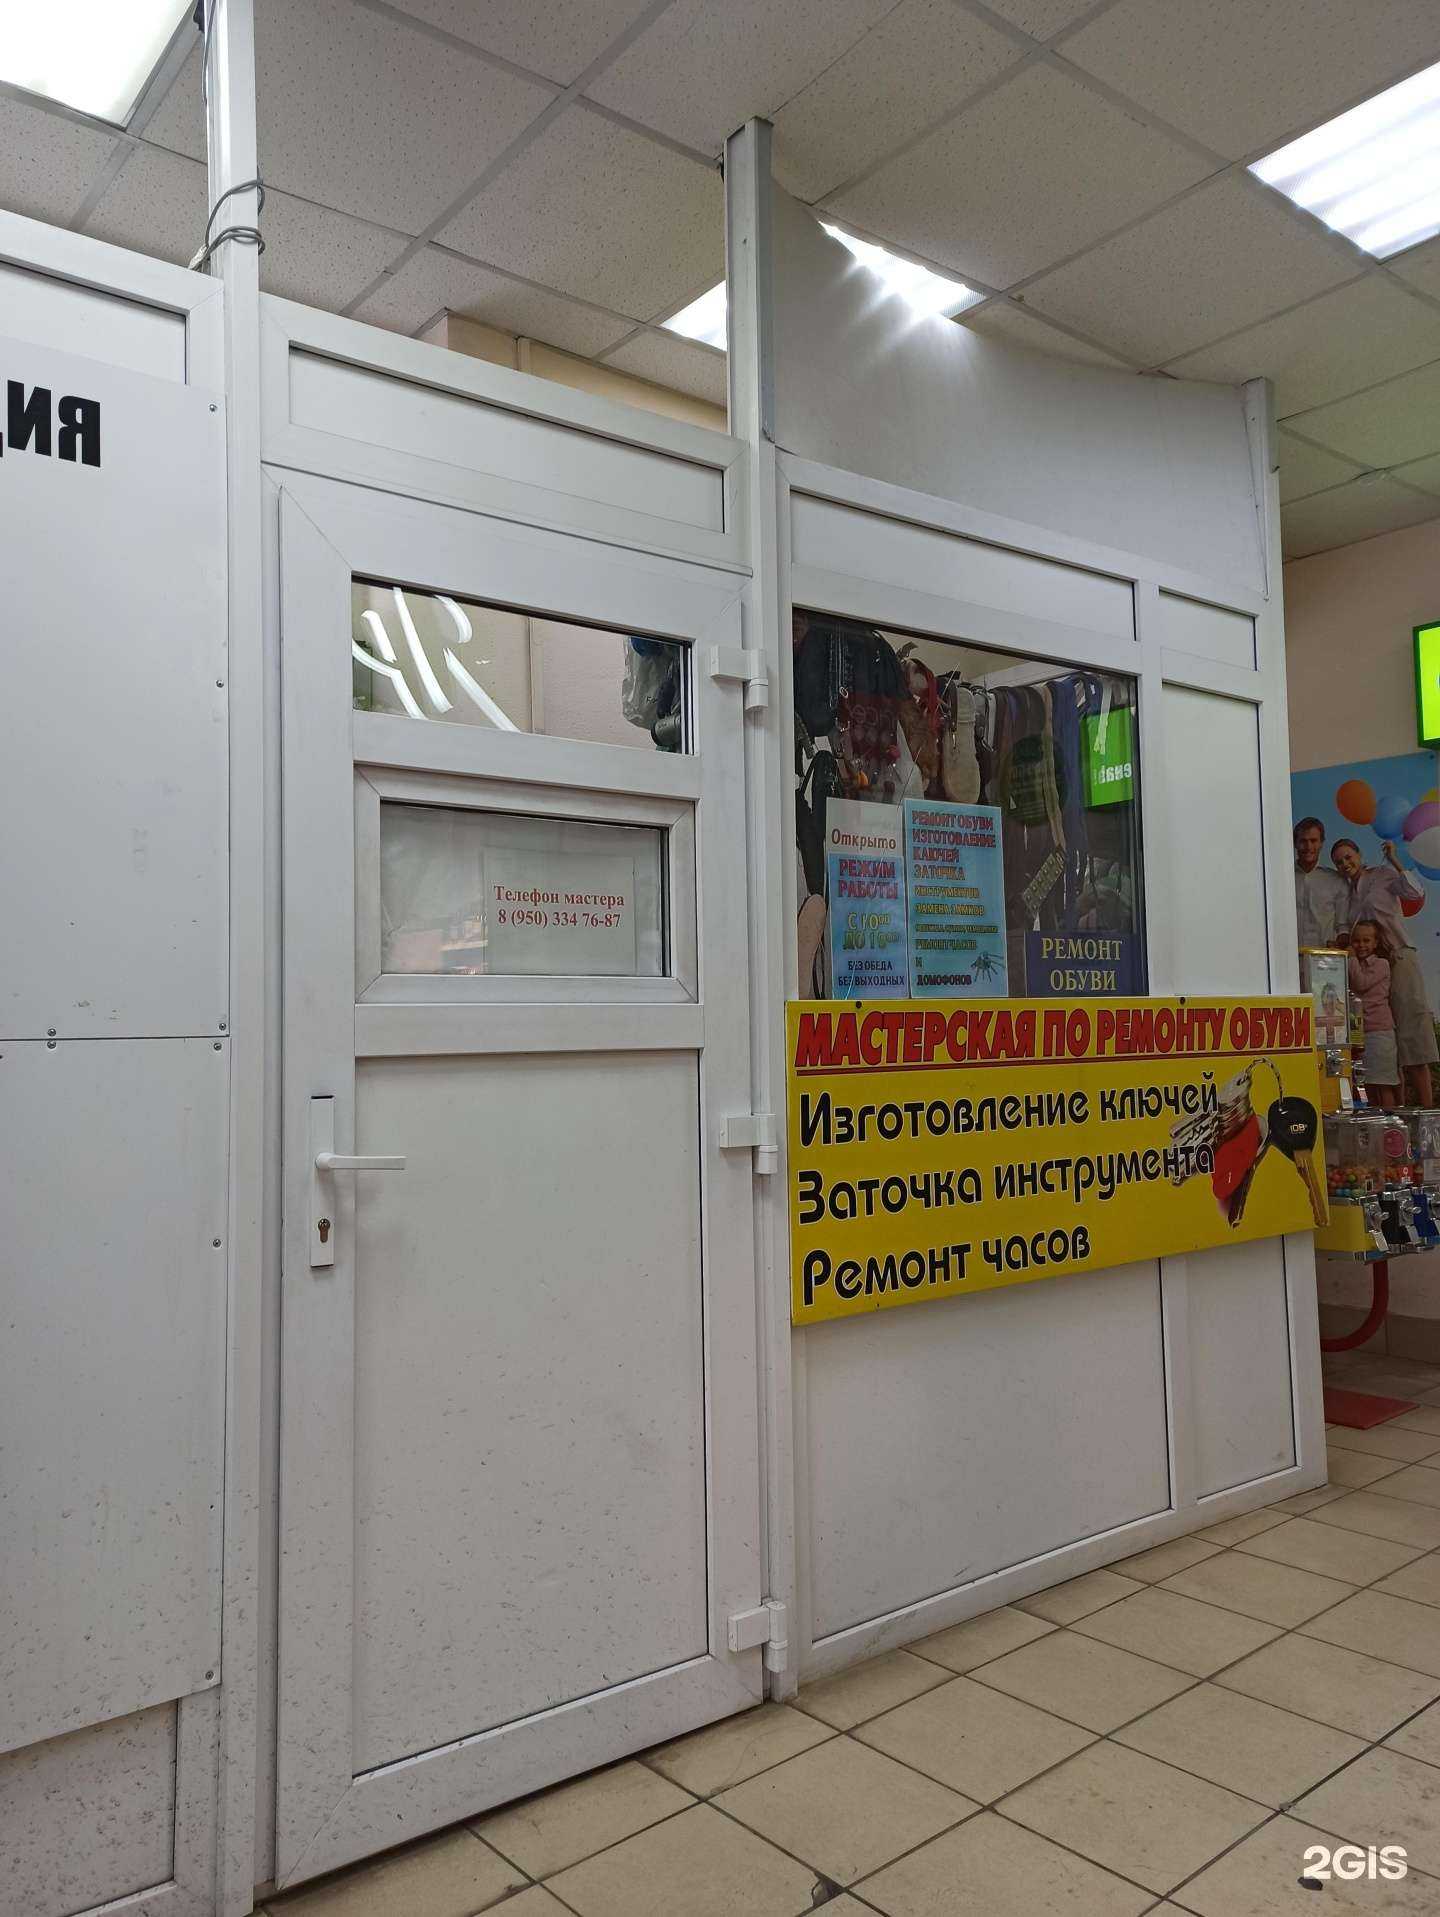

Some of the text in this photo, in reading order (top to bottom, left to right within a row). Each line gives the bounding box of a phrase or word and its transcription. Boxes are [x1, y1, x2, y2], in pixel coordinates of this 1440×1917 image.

[0, 379, 101, 468] ИЯ
[958, 814, 994, 832] ОБУВИ
[831, 828, 897, 850] Открыто
[838, 858, 896, 879] РЕЖИМ
[913, 863, 966, 881] ЗАТОЧКА
[493, 886, 625, 909] Телефон мастера
[837, 880, 899, 900] РАБОТЫ
[498, 909, 621, 928] 8 (950) 334 76-87
[847, 913, 858, 930] С
[843, 931, 866, 950] ДО
[1041, 937, 1123, 961] РЕМОНТ
[864, 960, 893, 972] ОБЕДА
[855, 975, 905, 987] ВЫХОДНЫХ
[916, 974, 973, 987] ДОМОФОНОВ
[1050, 969, 1118, 991] ОБУВИ
[795, 1006, 1311, 1067] МАСТЕРСКАЯ ПО РЕМОНТУ ОБУВИ
[799, 1071, 1219, 1148] Изготовление ключей
[798, 1140, 1217, 1225] Заточка инструмента
[802, 1225, 1091, 1307] Ремонт часов
